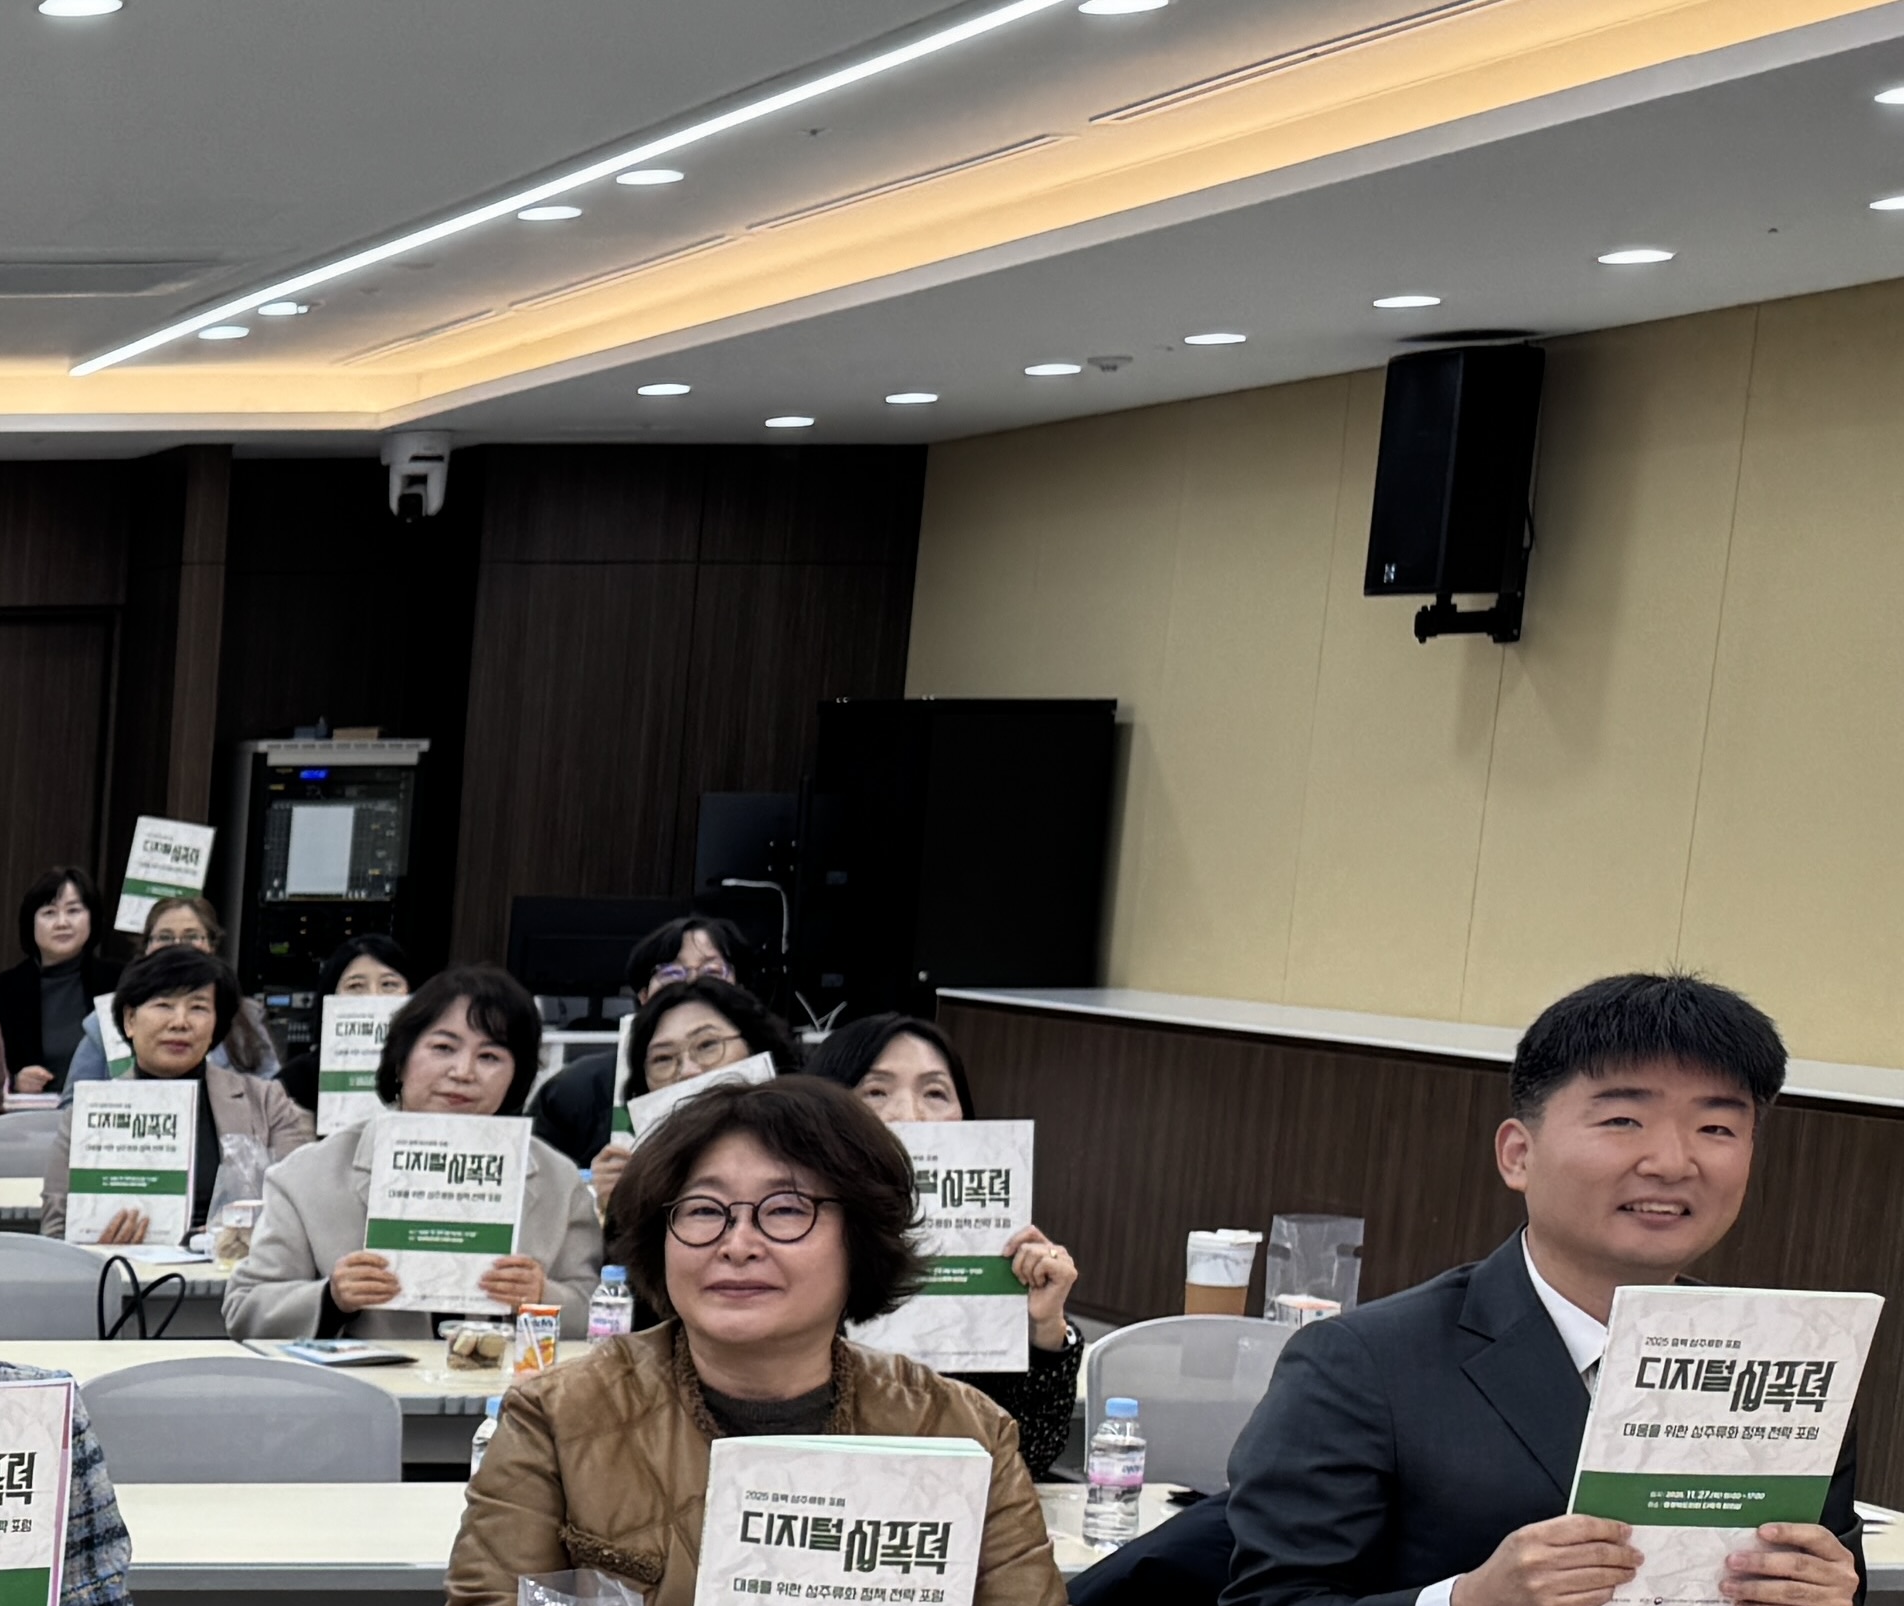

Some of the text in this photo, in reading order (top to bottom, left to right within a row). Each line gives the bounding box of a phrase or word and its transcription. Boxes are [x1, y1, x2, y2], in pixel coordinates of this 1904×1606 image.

[88, 1113, 177, 1139] 디지털 성폭력
[393, 1151, 503, 1186] 디지털 성폭력
[942, 1169, 1010, 1208] 성폭력
[1634, 1356, 1838, 1412] 디지털 성폭력
[1663, 1425, 1688, 1437] 위한
[1794, 1426, 1820, 1439] 포럼
[11, 1519, 32, 1532] 포럼
[738, 1510, 953, 1576] 디지털 성폭력
[775, 1581, 801, 1596] 위한
[918, 1589, 944, 1602] 포럼
